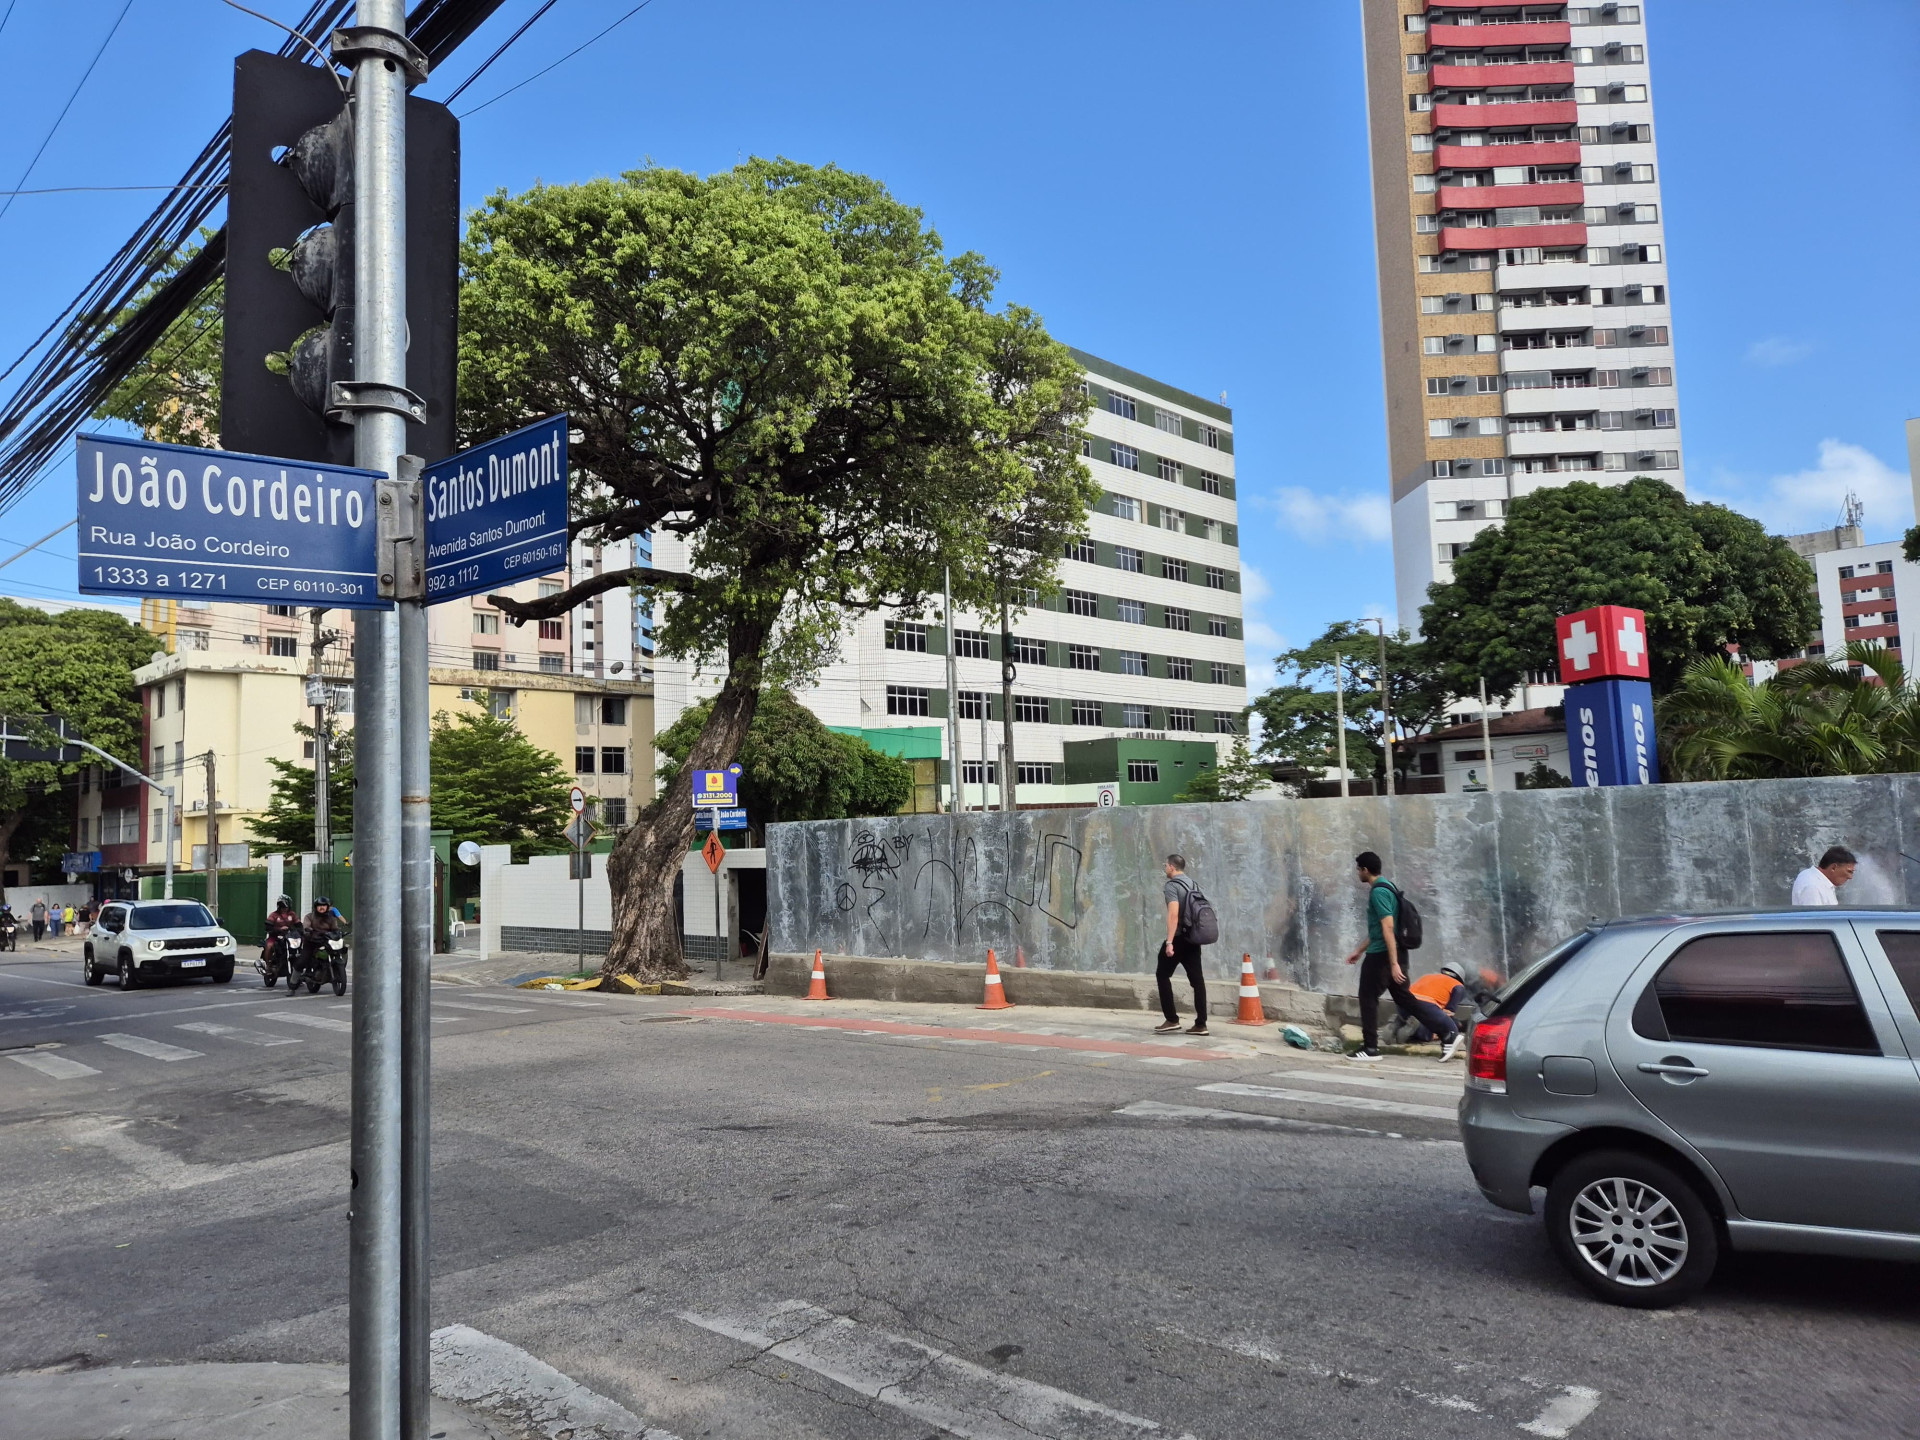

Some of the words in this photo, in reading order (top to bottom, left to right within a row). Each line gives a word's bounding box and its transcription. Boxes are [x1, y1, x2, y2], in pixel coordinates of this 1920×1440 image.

[89, 451, 187, 511] João
[202, 464, 363, 528] Cordeiro
[428, 465, 484, 522] Santos
[488, 429, 560, 503] Dumont
[91, 526, 136, 546] Rua
[144, 531, 197, 551] João
[203, 536, 290, 558] Cordeiro
[428, 538, 467, 559] Avenida
[469, 526, 503, 547] Santos
[505, 509, 546, 537] Dumont
[504, 553, 520, 570] CEP
[522, 542, 563, 565] 60150-161
[94, 566, 149, 586] 1333
[156, 574, 170, 587] a
[178, 571, 226, 590] 1271
[257, 577, 289, 591] CEP
[293, 580, 363, 595] 60110-301
[428, 573, 446, 592] 992
[449, 575, 455, 587] a
[457, 564, 479, 584] 1112
[1103, 794, 1110, 806] E
